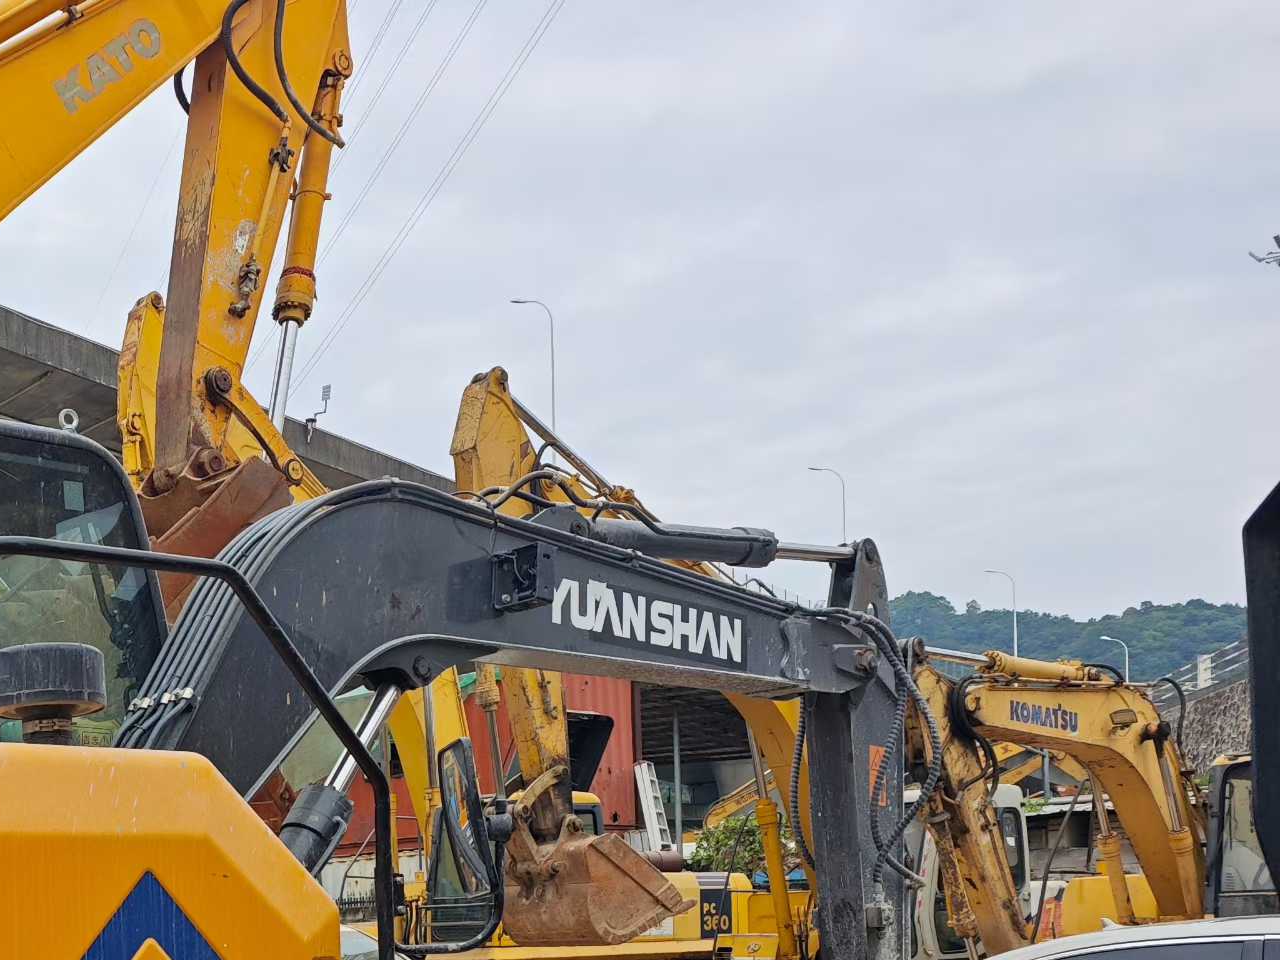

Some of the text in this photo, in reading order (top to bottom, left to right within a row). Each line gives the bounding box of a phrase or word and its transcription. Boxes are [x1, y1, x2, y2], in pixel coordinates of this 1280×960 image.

[53, 18, 161, 115] KATO
[551, 578, 742, 663] YUANSHAN
[1009, 699, 1079, 733] KOMATSU
[703, 902, 717, 914] PC
